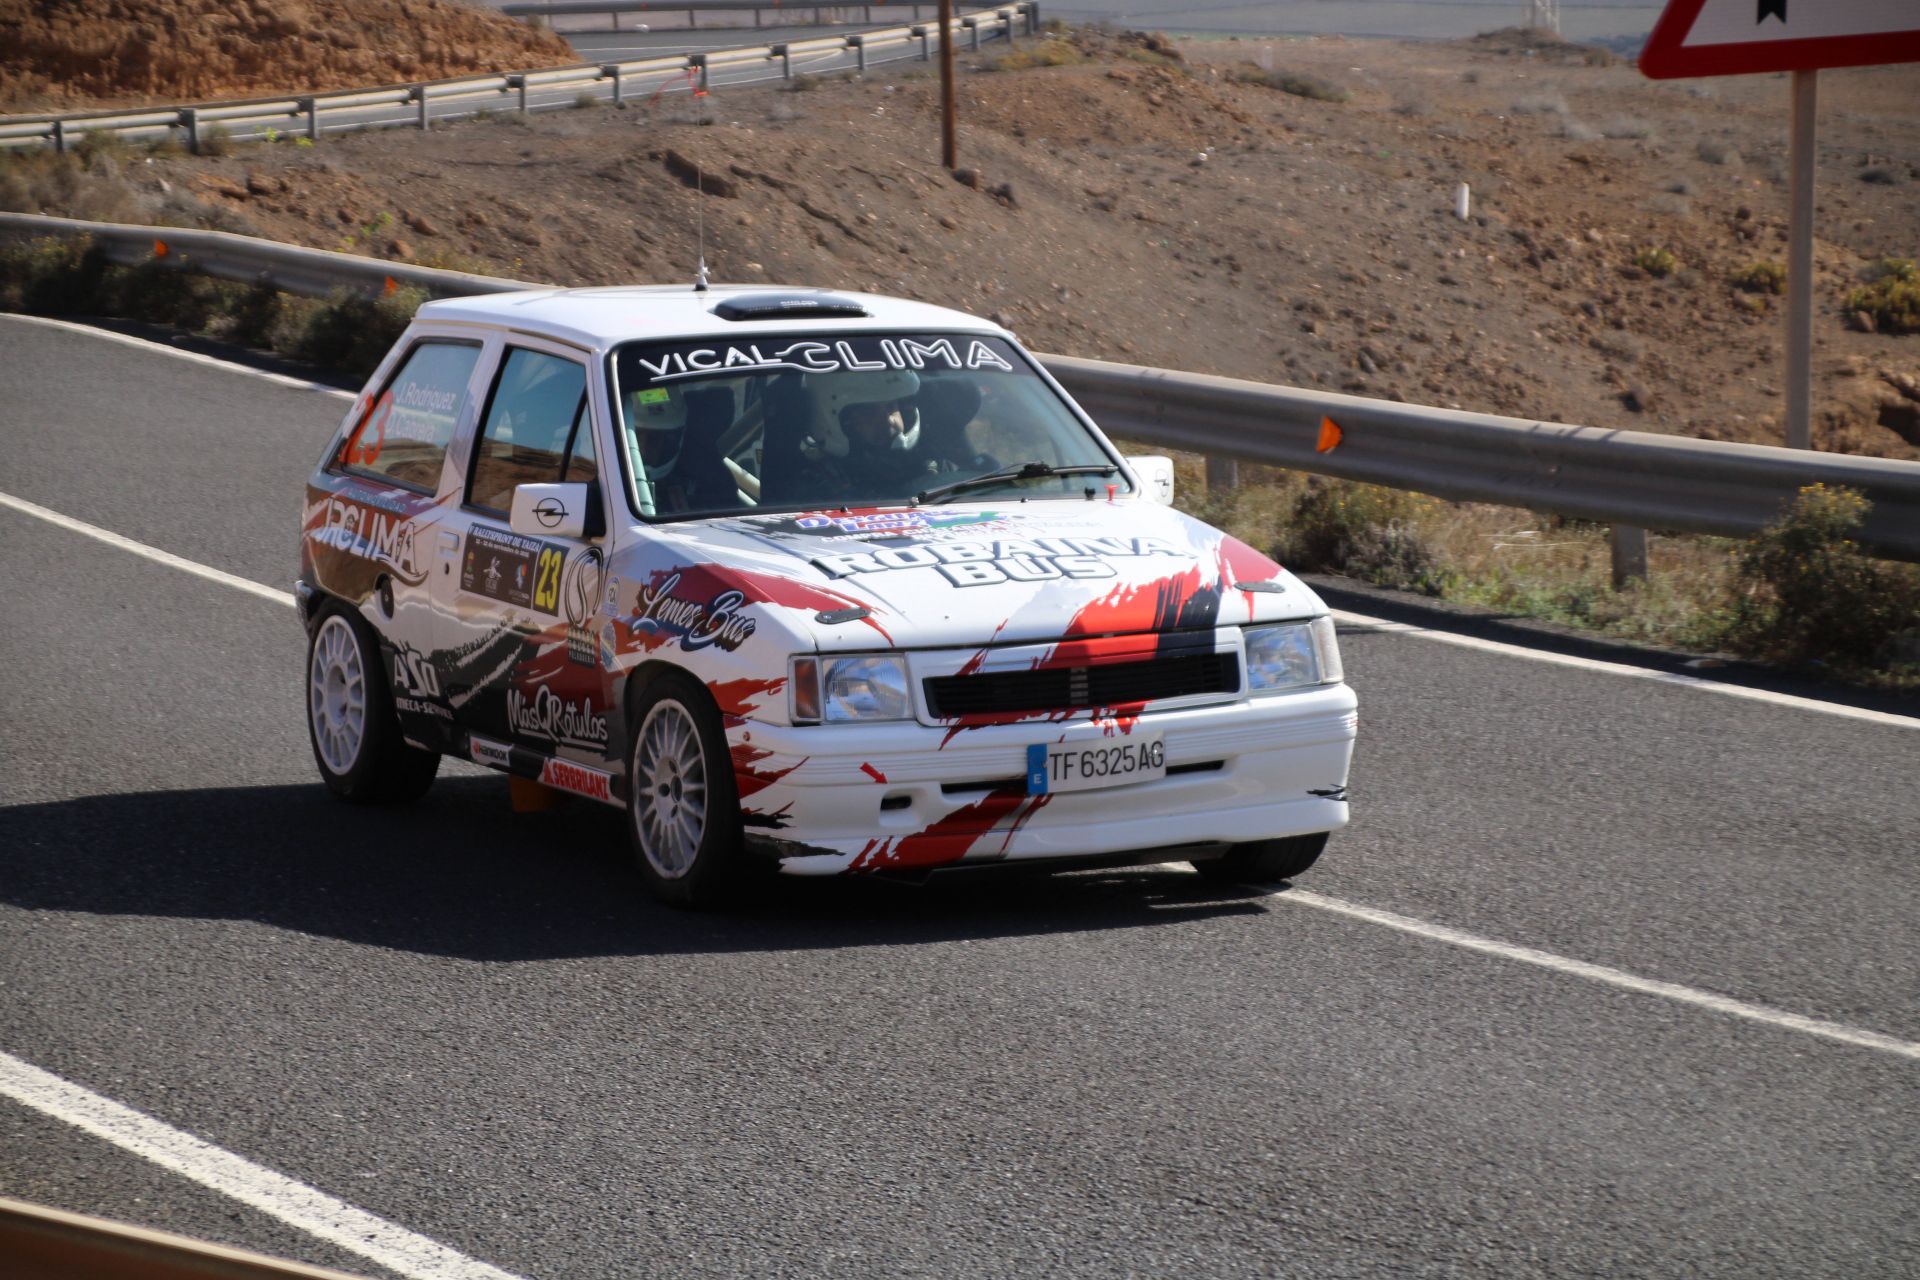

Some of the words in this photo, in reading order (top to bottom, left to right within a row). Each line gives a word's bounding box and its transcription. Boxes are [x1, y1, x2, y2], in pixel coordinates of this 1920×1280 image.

[535, 547, 562, 609] 23
[808, 536, 1197, 580] ROBAINA
[934, 555, 1118, 589] BUS
[632, 573, 703, 630] Lemes
[688, 590, 756, 643] Bus
[1033, 773, 1042, 784] E
